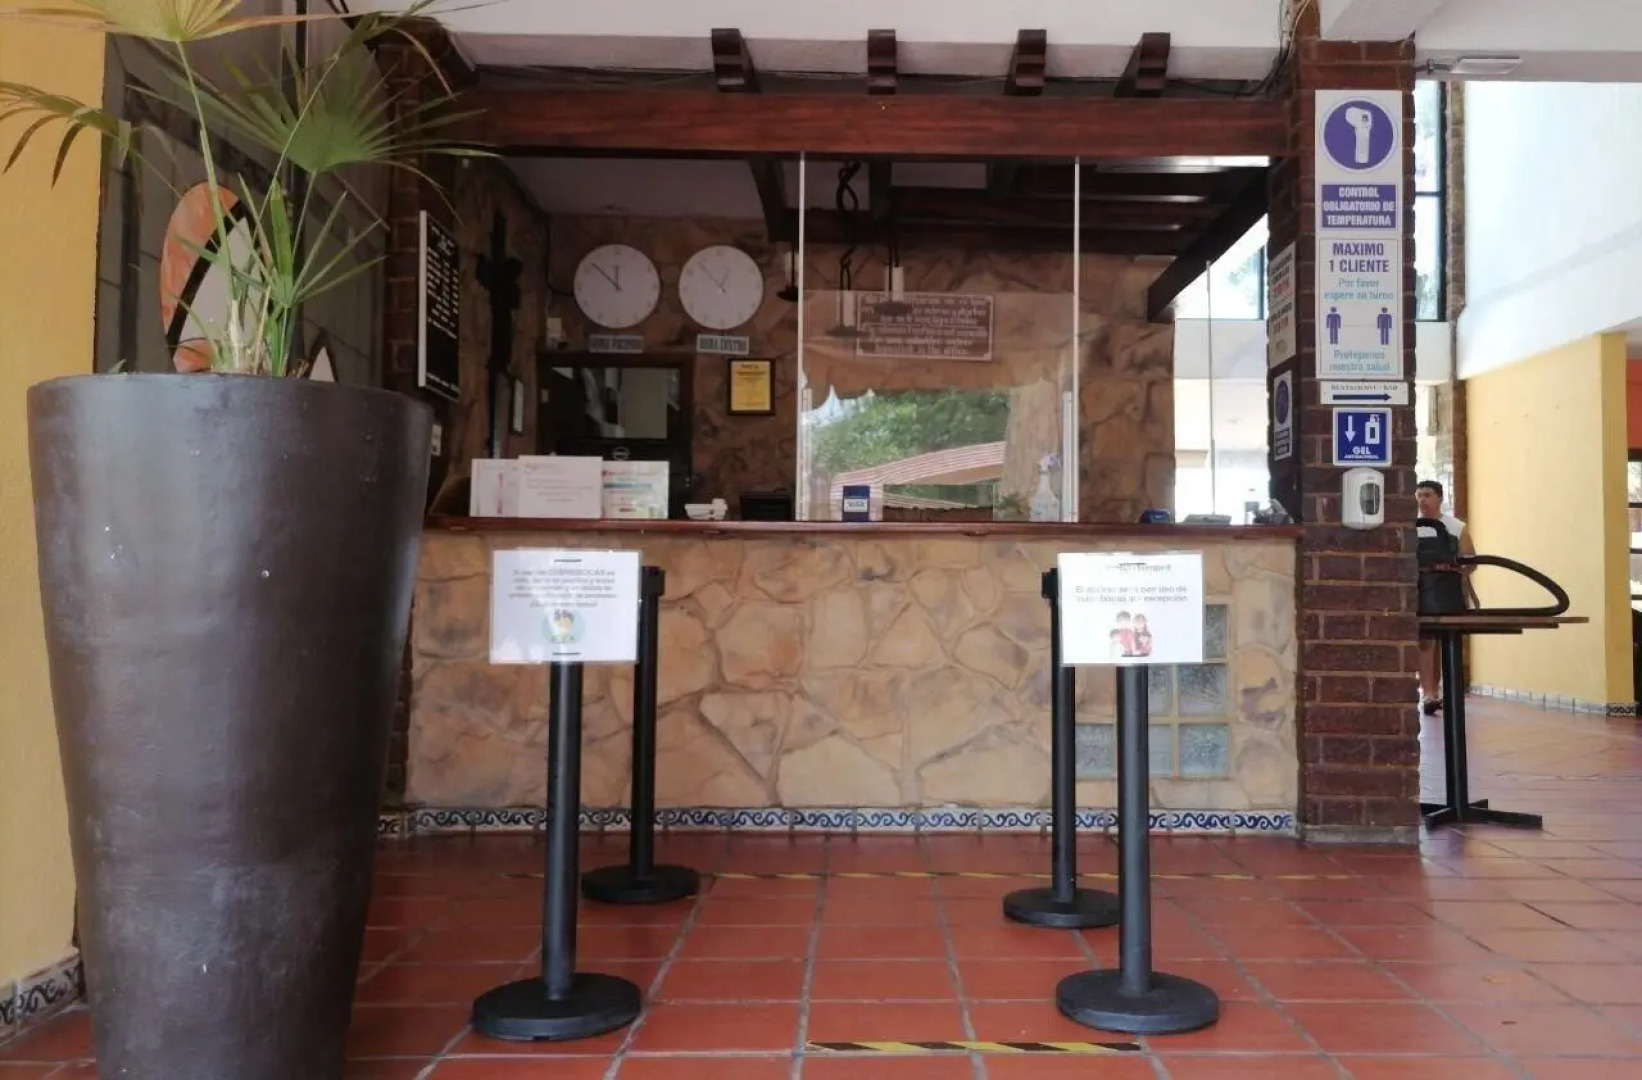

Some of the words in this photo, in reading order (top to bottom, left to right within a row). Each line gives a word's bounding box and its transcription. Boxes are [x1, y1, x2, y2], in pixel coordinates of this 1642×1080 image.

[1338, 186, 1380, 198] CONTROL
[1323, 200, 1381, 211] OBLIGATORIO
[1382, 201, 1396, 212] DE
[1326, 214, 1392, 226] TEMPERATURA
[1333, 243, 1384, 256] MAXIMO
[1328, 259, 1335, 273] 1
[1339, 259, 1389, 273] CLIENTE
[1338, 277, 1353, 287] Por
[1356, 277, 1380, 287] favor
[1323, 291, 1354, 301] espere
[1369, 291, 1394, 300] turno
[1365, 362, 1390, 371] salud
[1352, 446, 1371, 455] GEL
